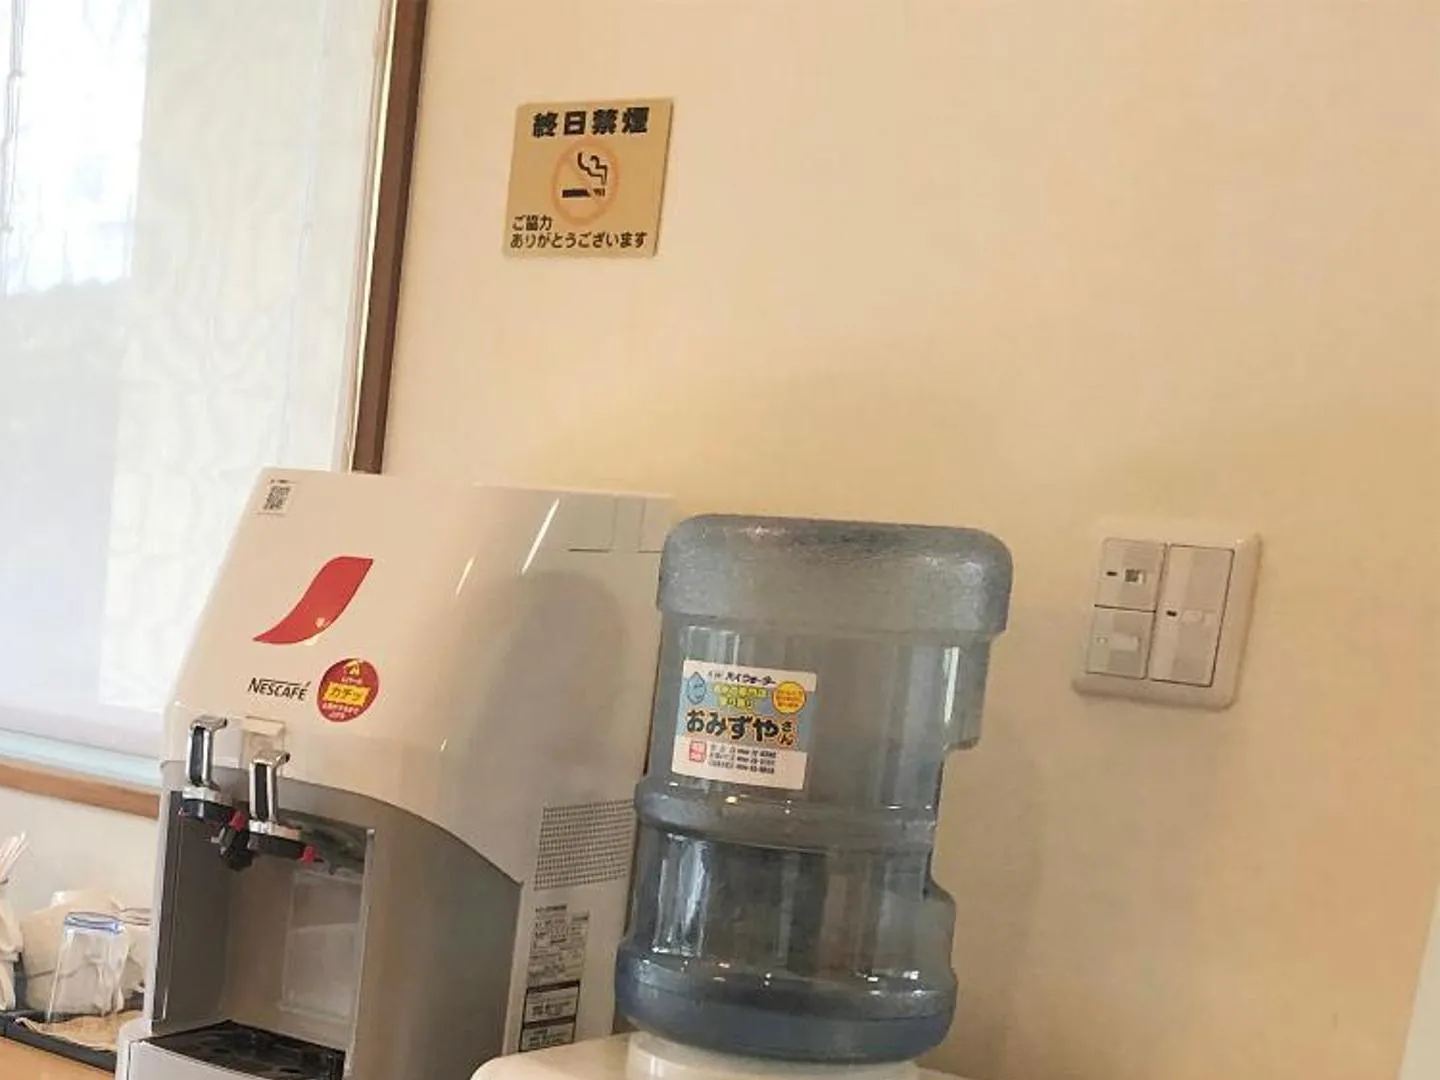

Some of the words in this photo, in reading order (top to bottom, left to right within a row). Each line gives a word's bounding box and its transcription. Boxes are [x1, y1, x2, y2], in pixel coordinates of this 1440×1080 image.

[531, 106, 650, 138] 終日禁煙
[511, 214, 553, 232] ご協力
[510, 231, 648, 249] ありがとうございます
